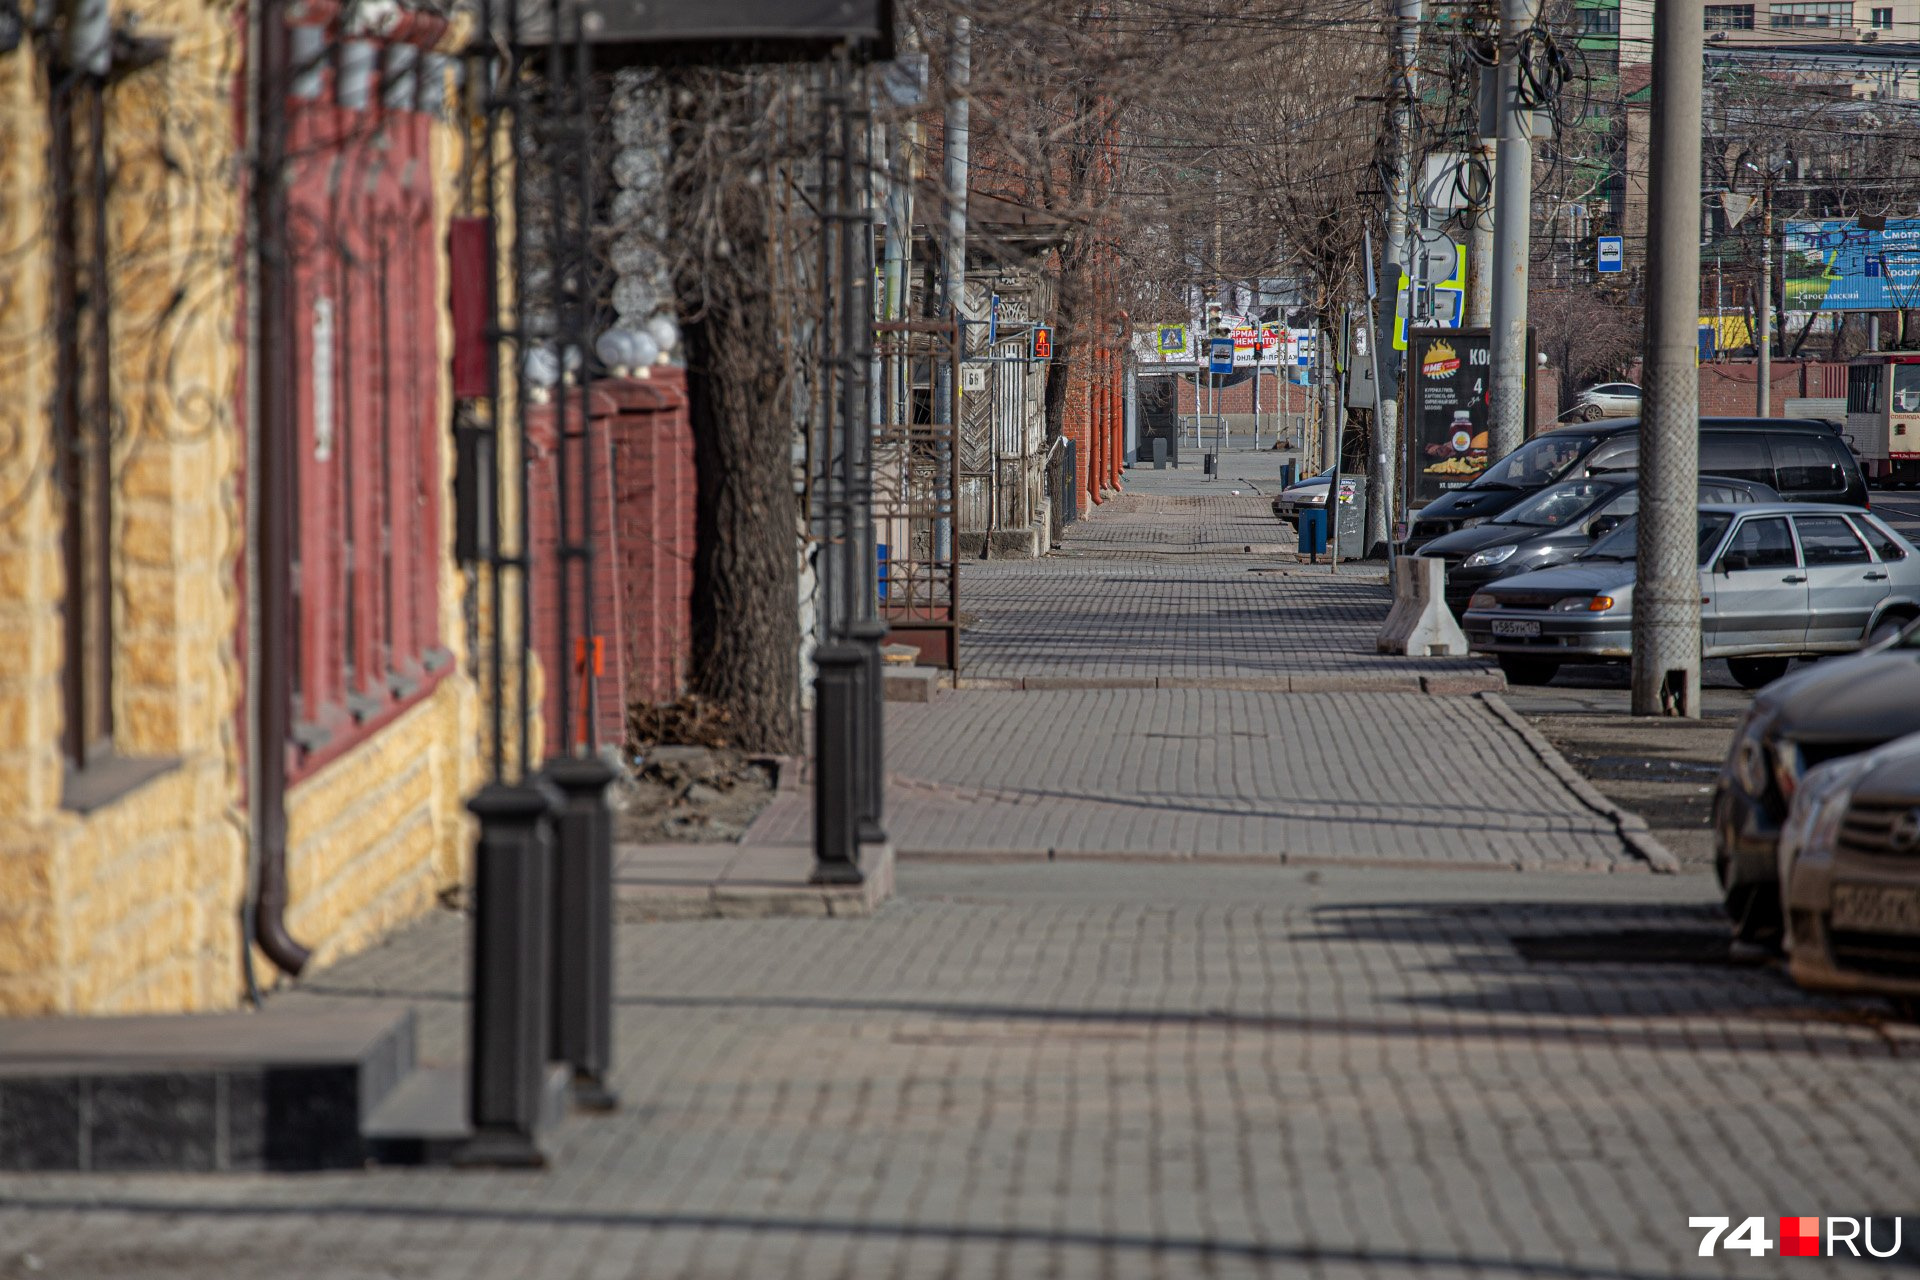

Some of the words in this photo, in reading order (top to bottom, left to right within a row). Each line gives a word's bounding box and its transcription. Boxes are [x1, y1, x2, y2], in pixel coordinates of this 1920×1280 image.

[1802, 290, 1859, 300] ЯРОСЛАВСКИЙ
[1036, 343, 1050, 357] 50
[1473, 377, 1483, 395] 4
